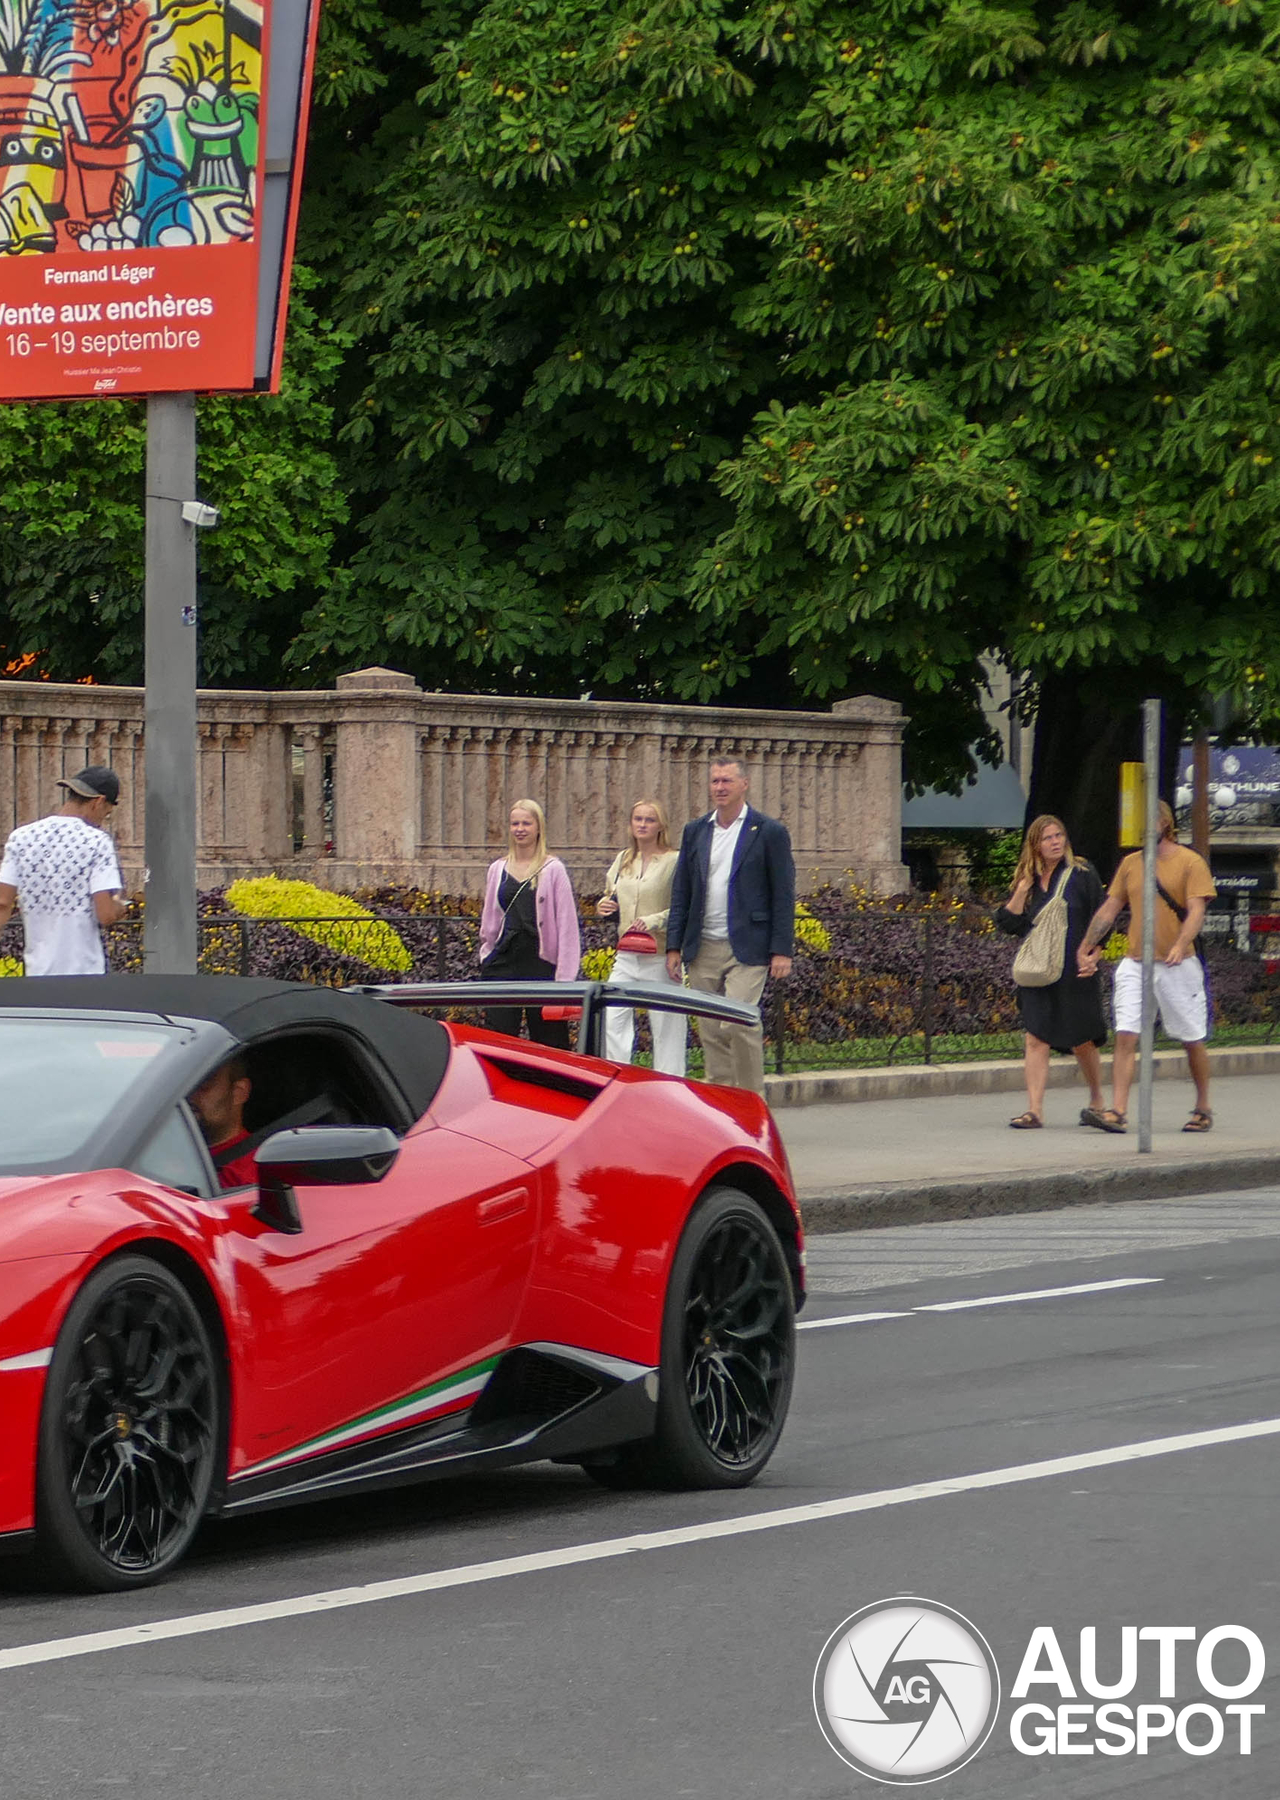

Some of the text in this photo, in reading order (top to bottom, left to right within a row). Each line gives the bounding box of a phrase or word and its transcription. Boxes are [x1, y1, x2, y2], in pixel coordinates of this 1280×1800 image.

[44, 264, 155, 285] Fernand Léger
[60, 303, 102, 322] aux
[106, 293, 213, 320] enchères
[6, 332, 31, 356] 16
[51, 330, 75, 354] 19
[81, 325, 200, 357] septembre
